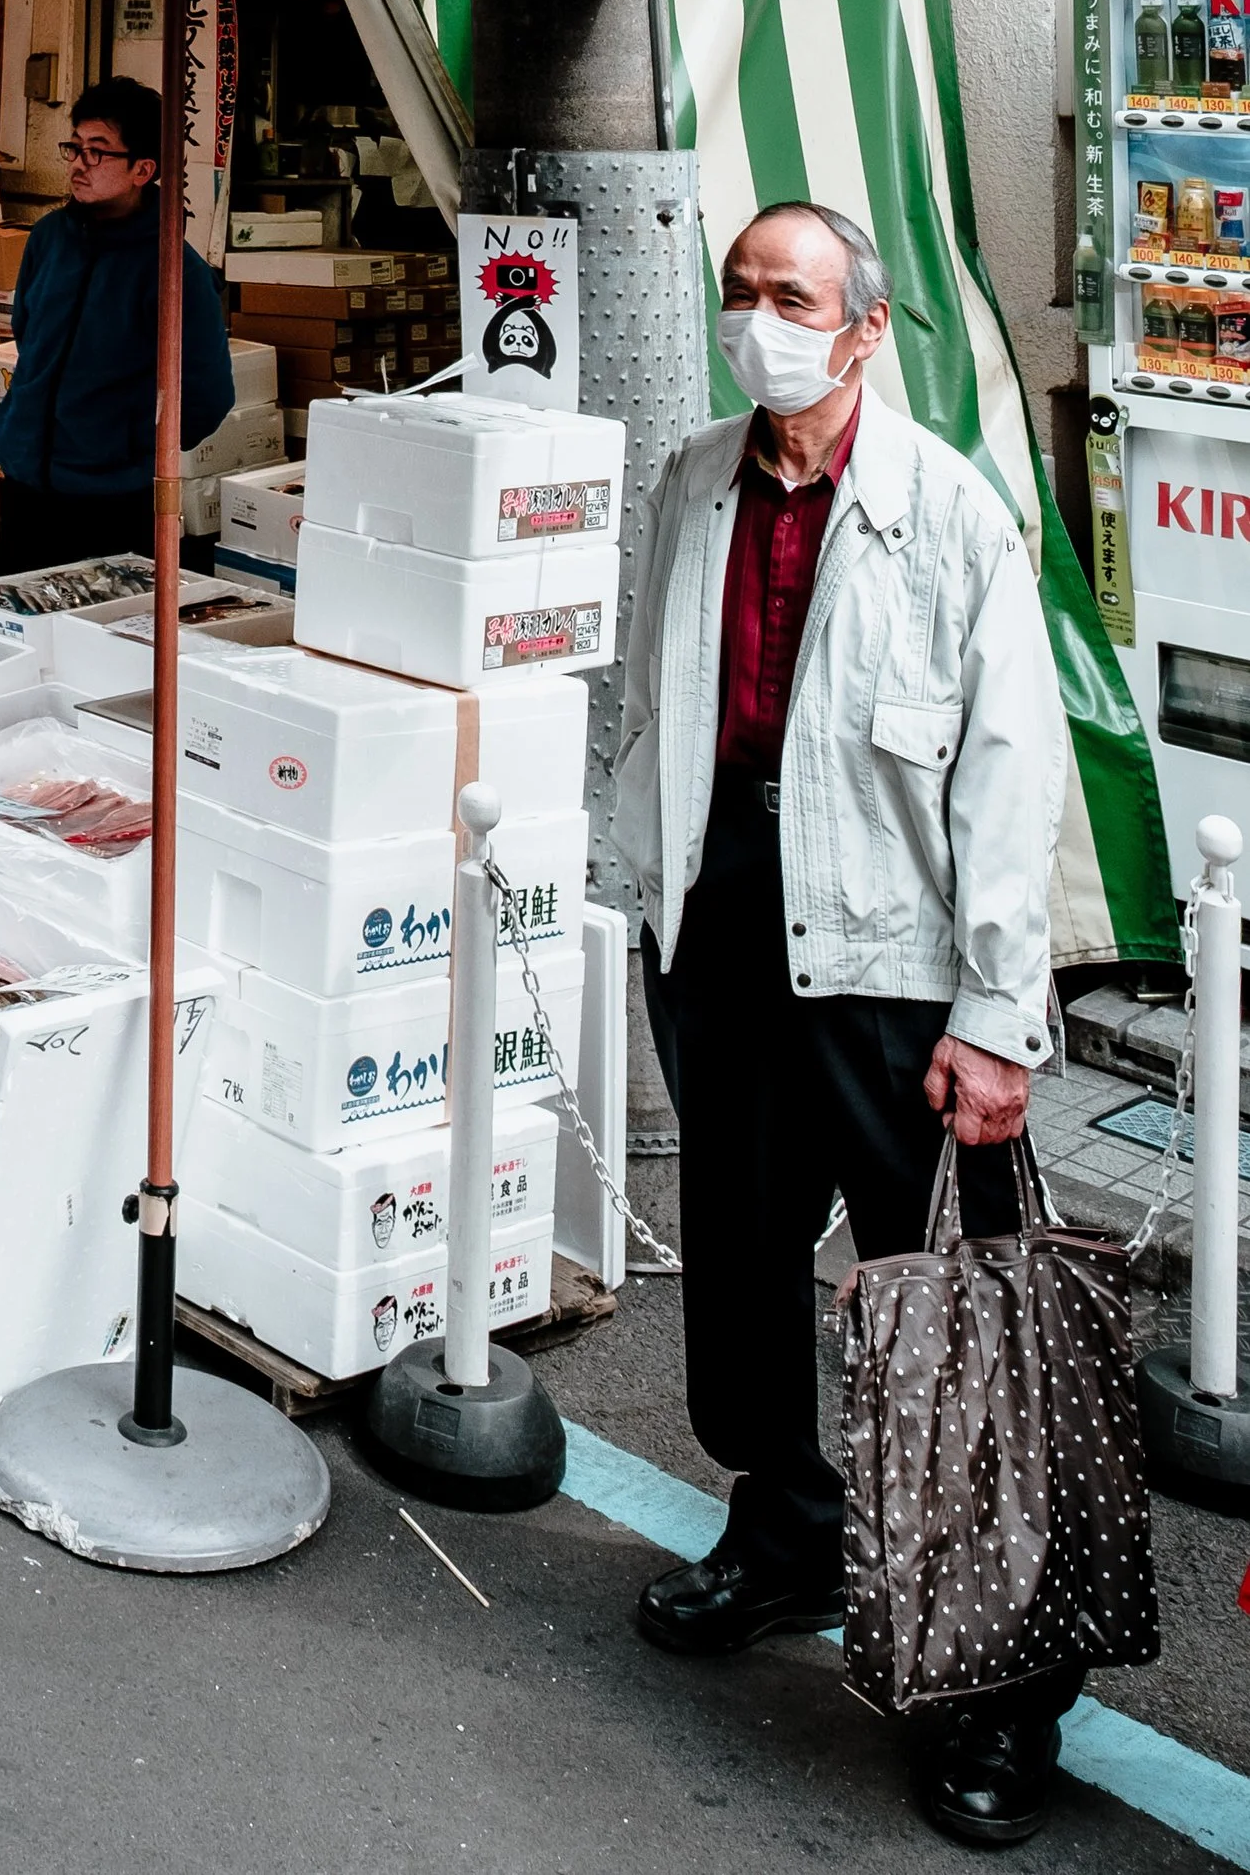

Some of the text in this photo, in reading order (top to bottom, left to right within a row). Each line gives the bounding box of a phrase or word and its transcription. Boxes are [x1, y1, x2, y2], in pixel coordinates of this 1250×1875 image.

[1157, 481, 1250, 543] KIR
[1101, 511, 1118, 588] 使えます。
[494, 1026, 548, 1074] 銀鮭
[222, 1078, 244, 1104] 7枚
